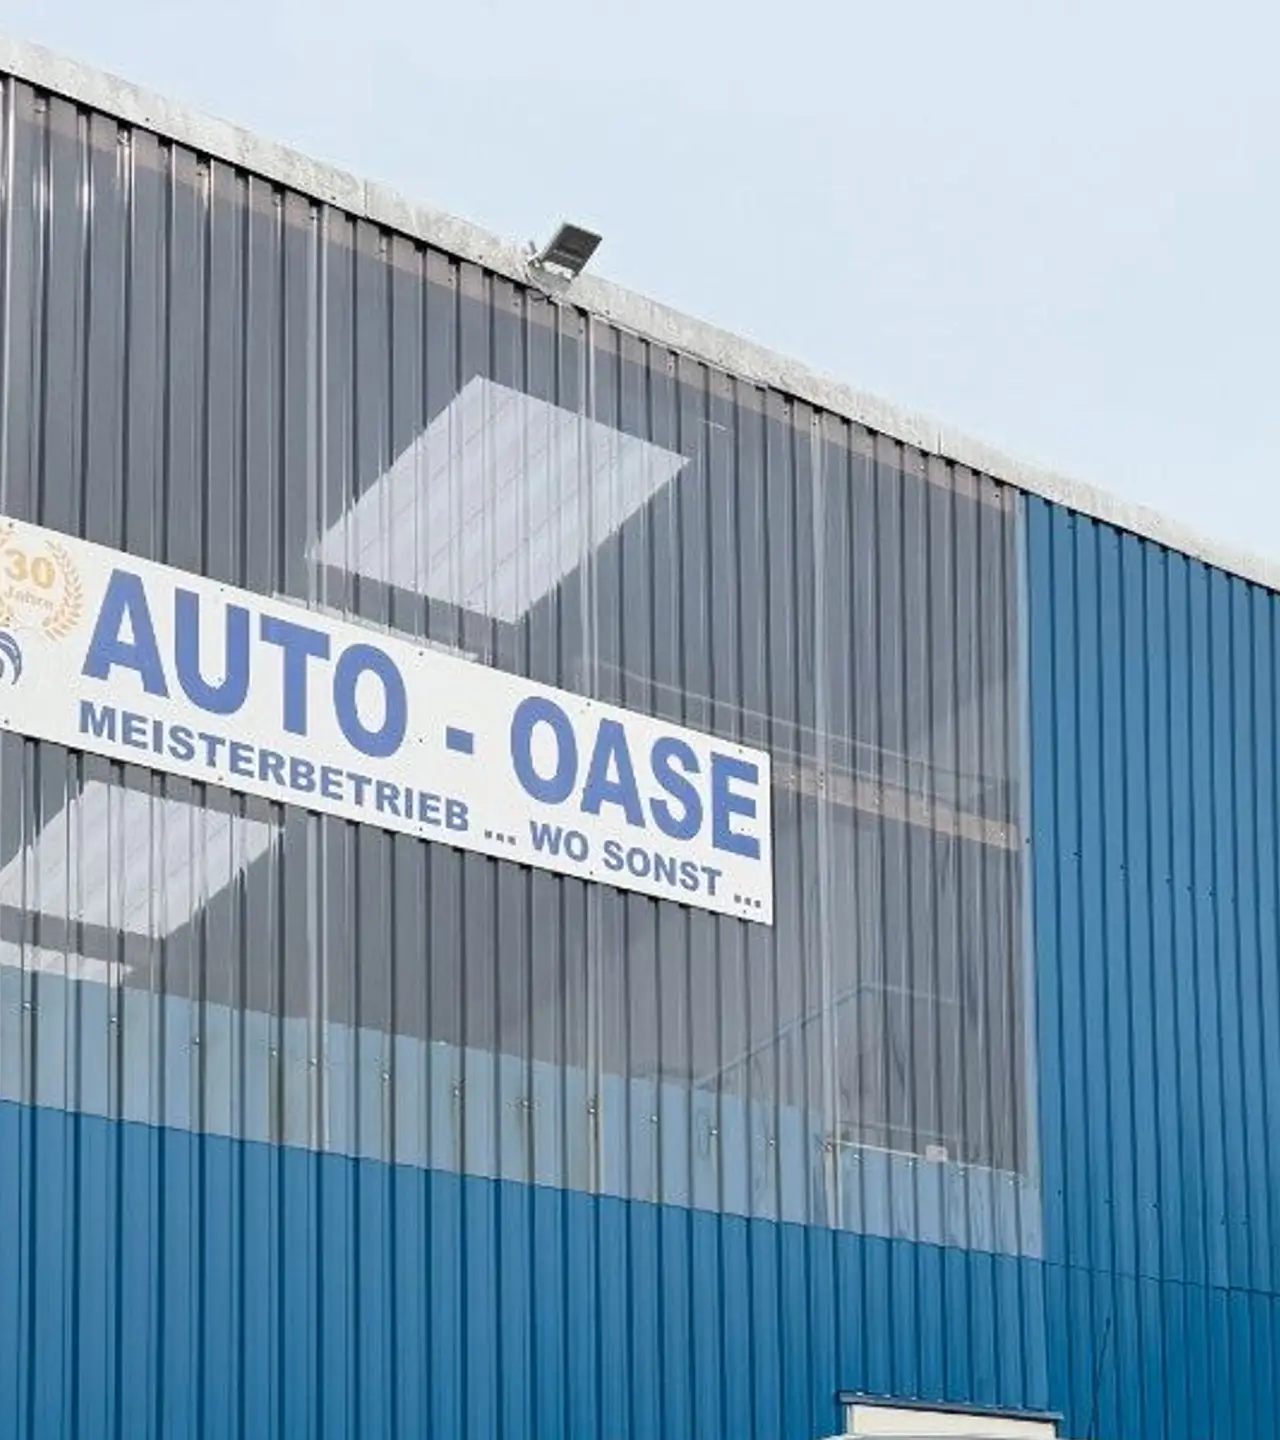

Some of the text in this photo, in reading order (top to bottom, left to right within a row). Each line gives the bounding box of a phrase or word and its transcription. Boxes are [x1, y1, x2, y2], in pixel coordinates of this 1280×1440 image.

[4, 548, 56, 589] 30
[79, 700, 470, 832] MEISTERBETRIEB
[530, 821, 589, 862] WO
[603, 840, 723, 897] SONST
[83, 570, 408, 759] AUTO
[510, 696, 762, 861] OASE
